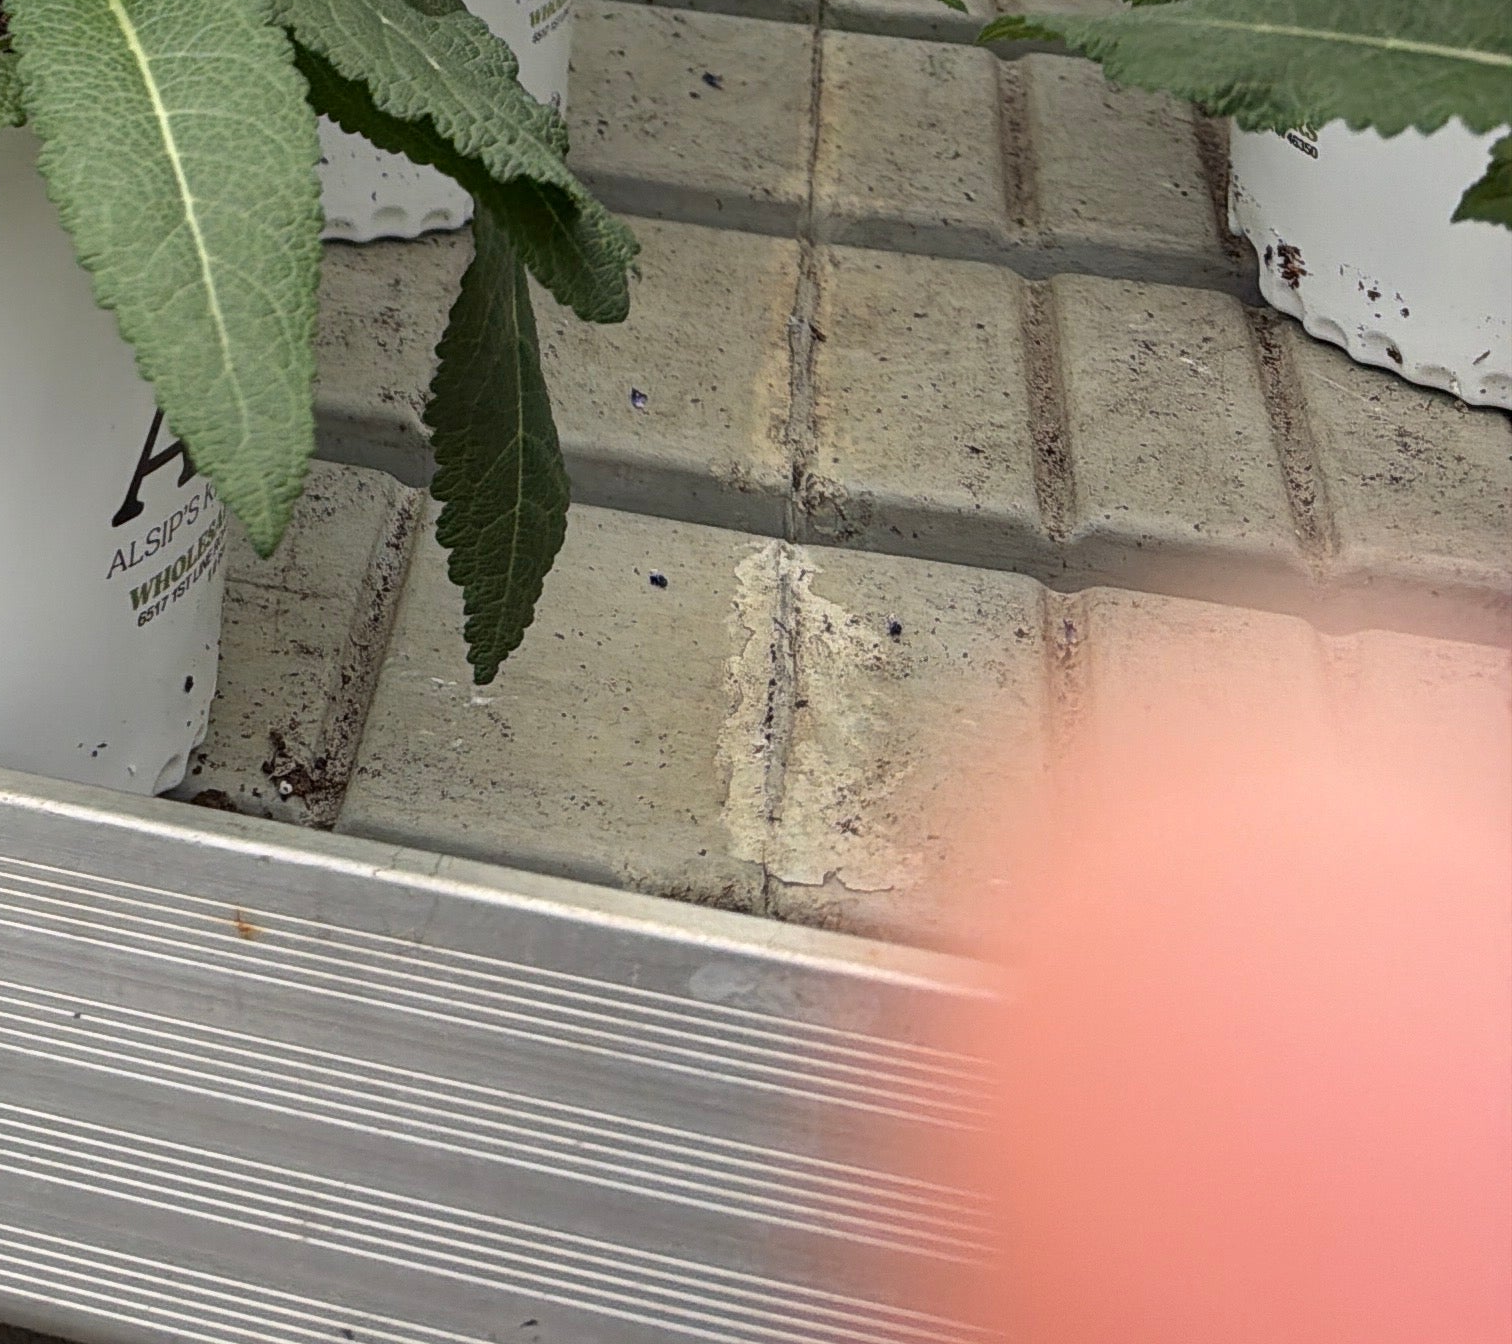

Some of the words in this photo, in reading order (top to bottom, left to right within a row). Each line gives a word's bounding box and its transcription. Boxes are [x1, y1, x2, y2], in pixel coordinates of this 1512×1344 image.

[106, 494, 201, 580] ALSIP'S
[138, 593, 169, 628] 6517
[172, 574, 192, 603] 1ST
